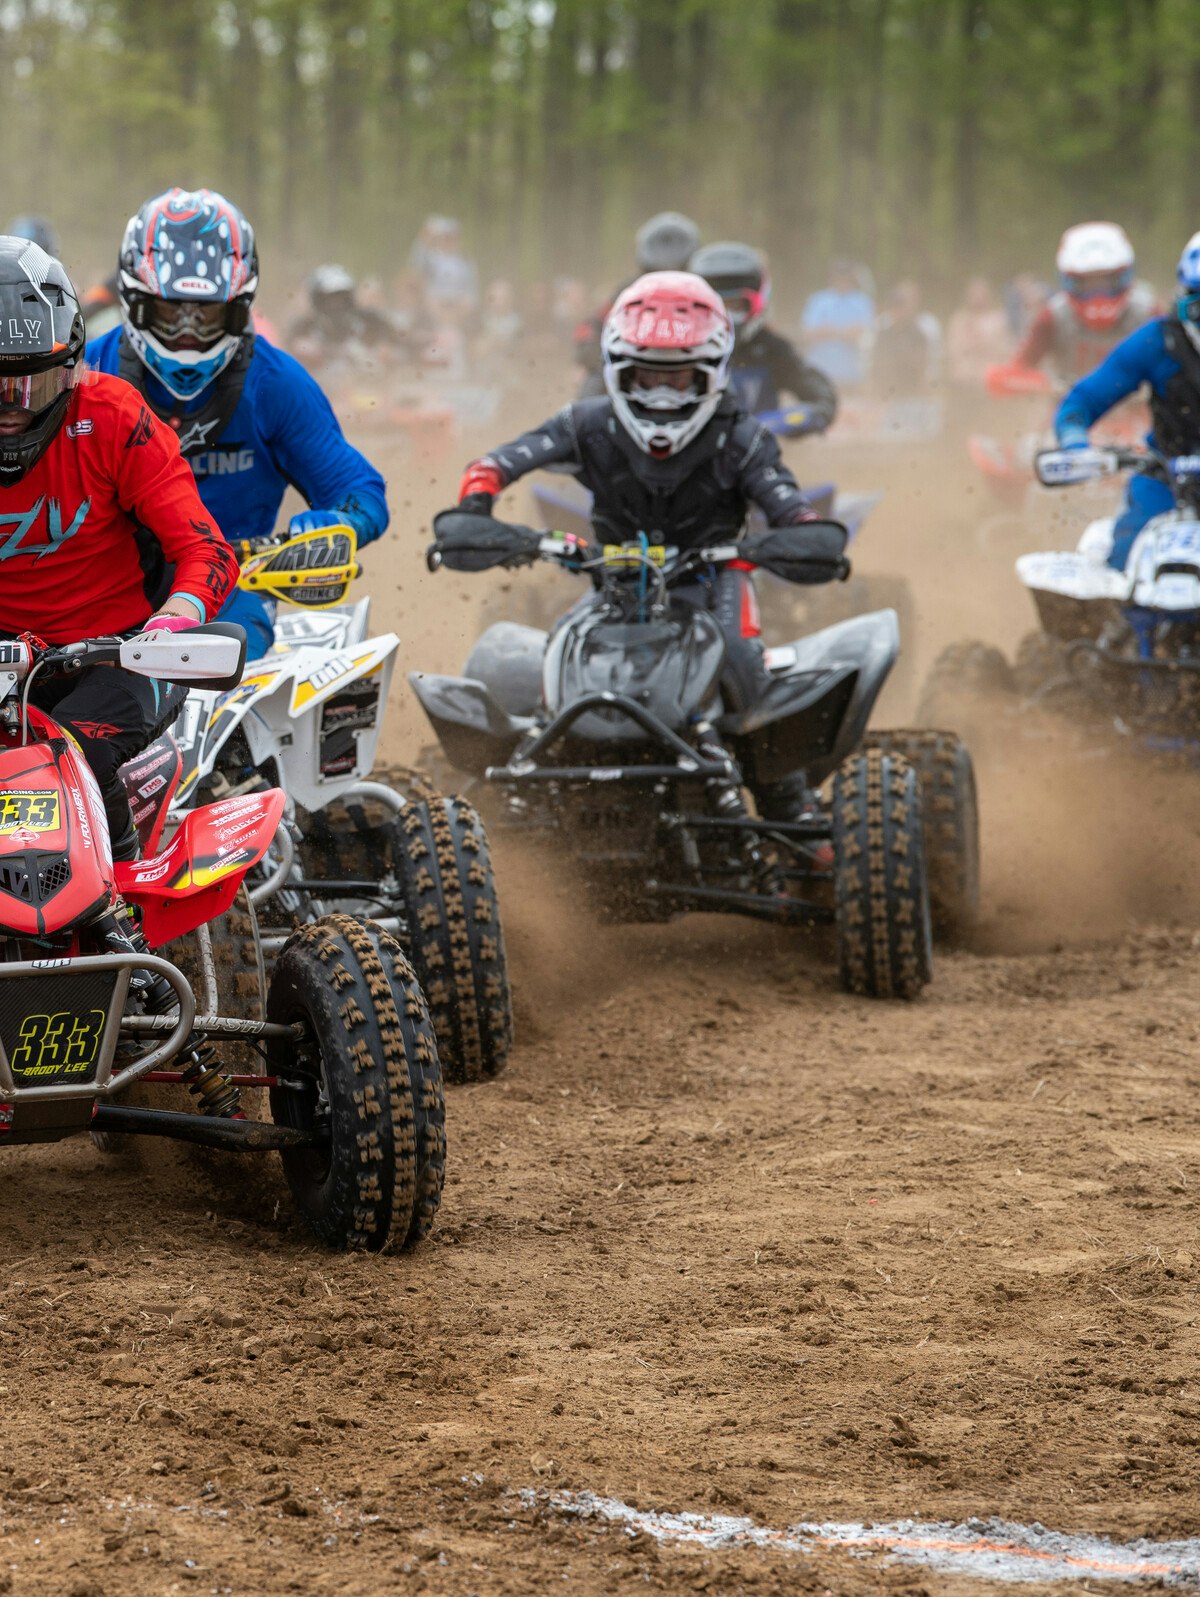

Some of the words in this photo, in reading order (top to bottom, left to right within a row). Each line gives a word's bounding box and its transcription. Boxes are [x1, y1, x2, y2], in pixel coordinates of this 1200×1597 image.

[181, 281, 210, 290] BELL
[3, 452, 18, 461] FLY
[191, 449, 254, 475] CING
[142, 778, 162, 793] TMS
[27, 820, 53, 828] LEE
[225, 812, 268, 836] ROCKET
[142, 865, 167, 879] TMS
[12, 1010, 104, 1072] 333
[23, 1064, 63, 1076] BRODY
[63, 1061, 90, 1073] LEE
